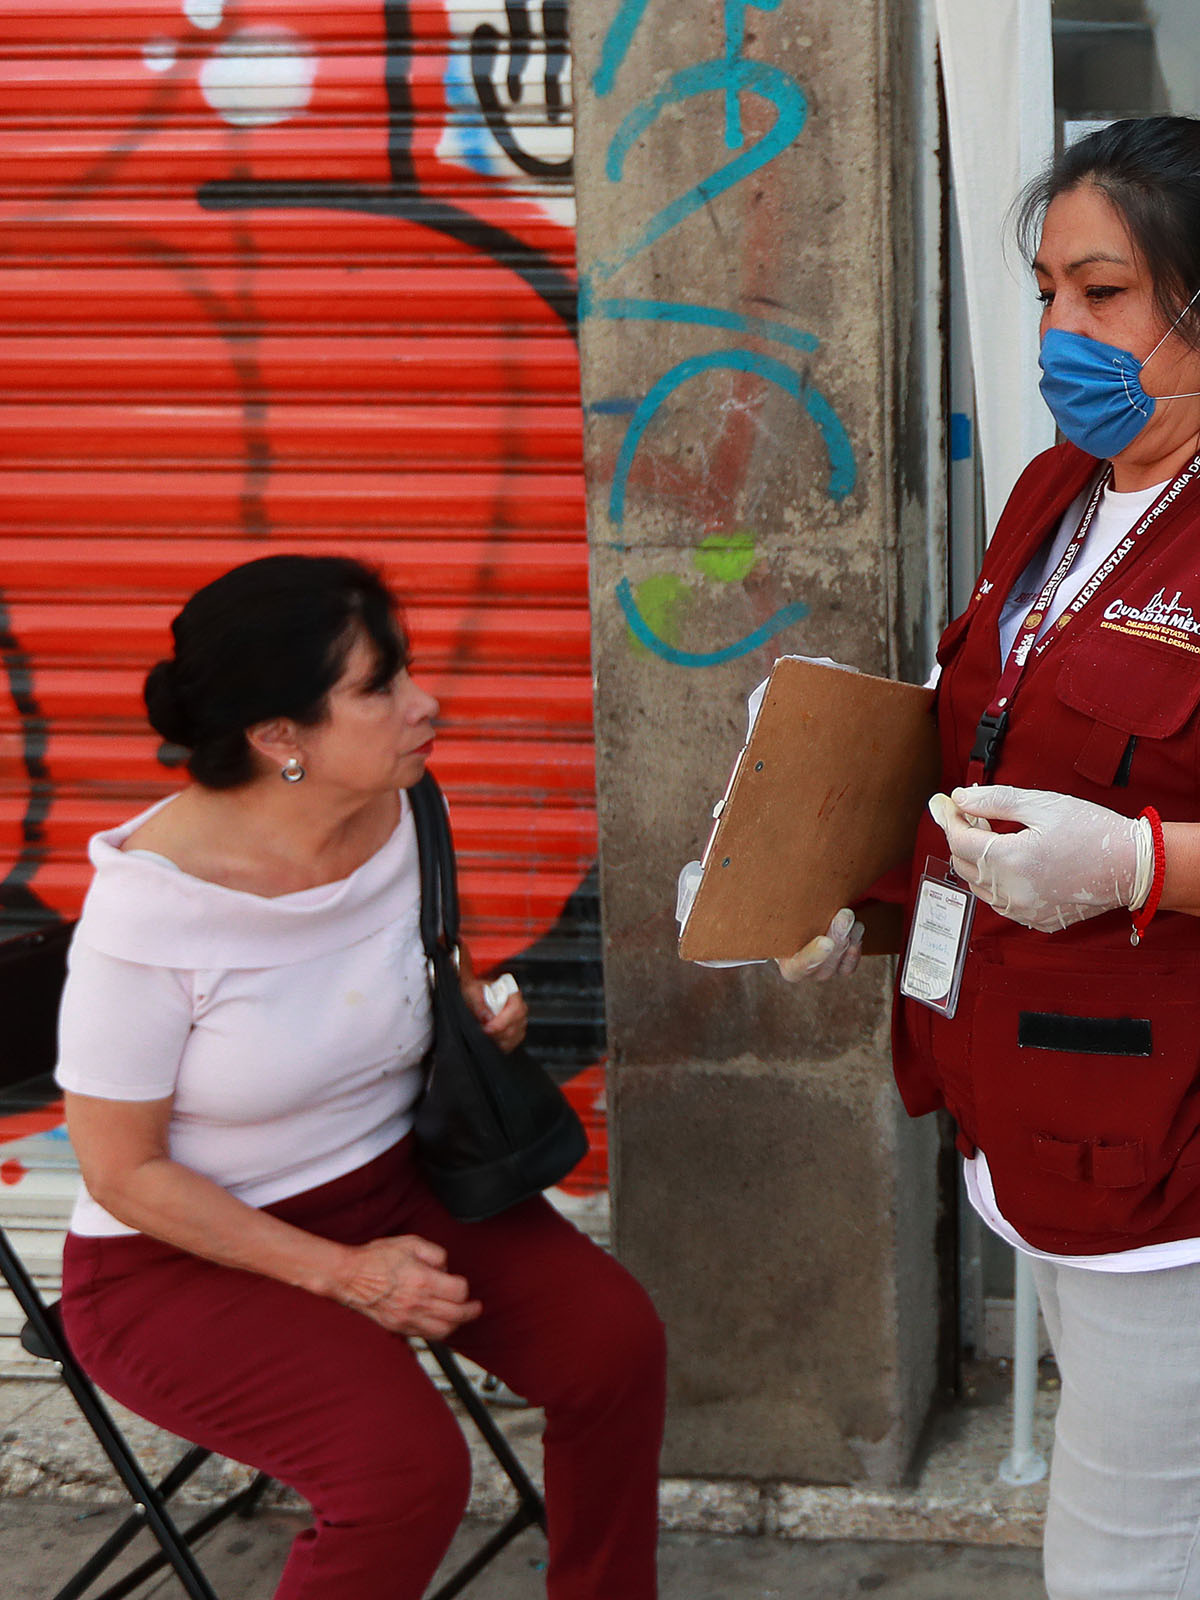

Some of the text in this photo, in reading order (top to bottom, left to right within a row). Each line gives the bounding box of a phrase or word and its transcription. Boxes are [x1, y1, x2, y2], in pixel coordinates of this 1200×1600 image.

[1034, 542, 1079, 611] BIENESTAR
[1071, 537, 1136, 613] BIENESTAR
[1103, 599, 1154, 623] CIUDAD
[1153, 613, 1168, 625] DE
[1160, 625, 1190, 641] ESTATAL
